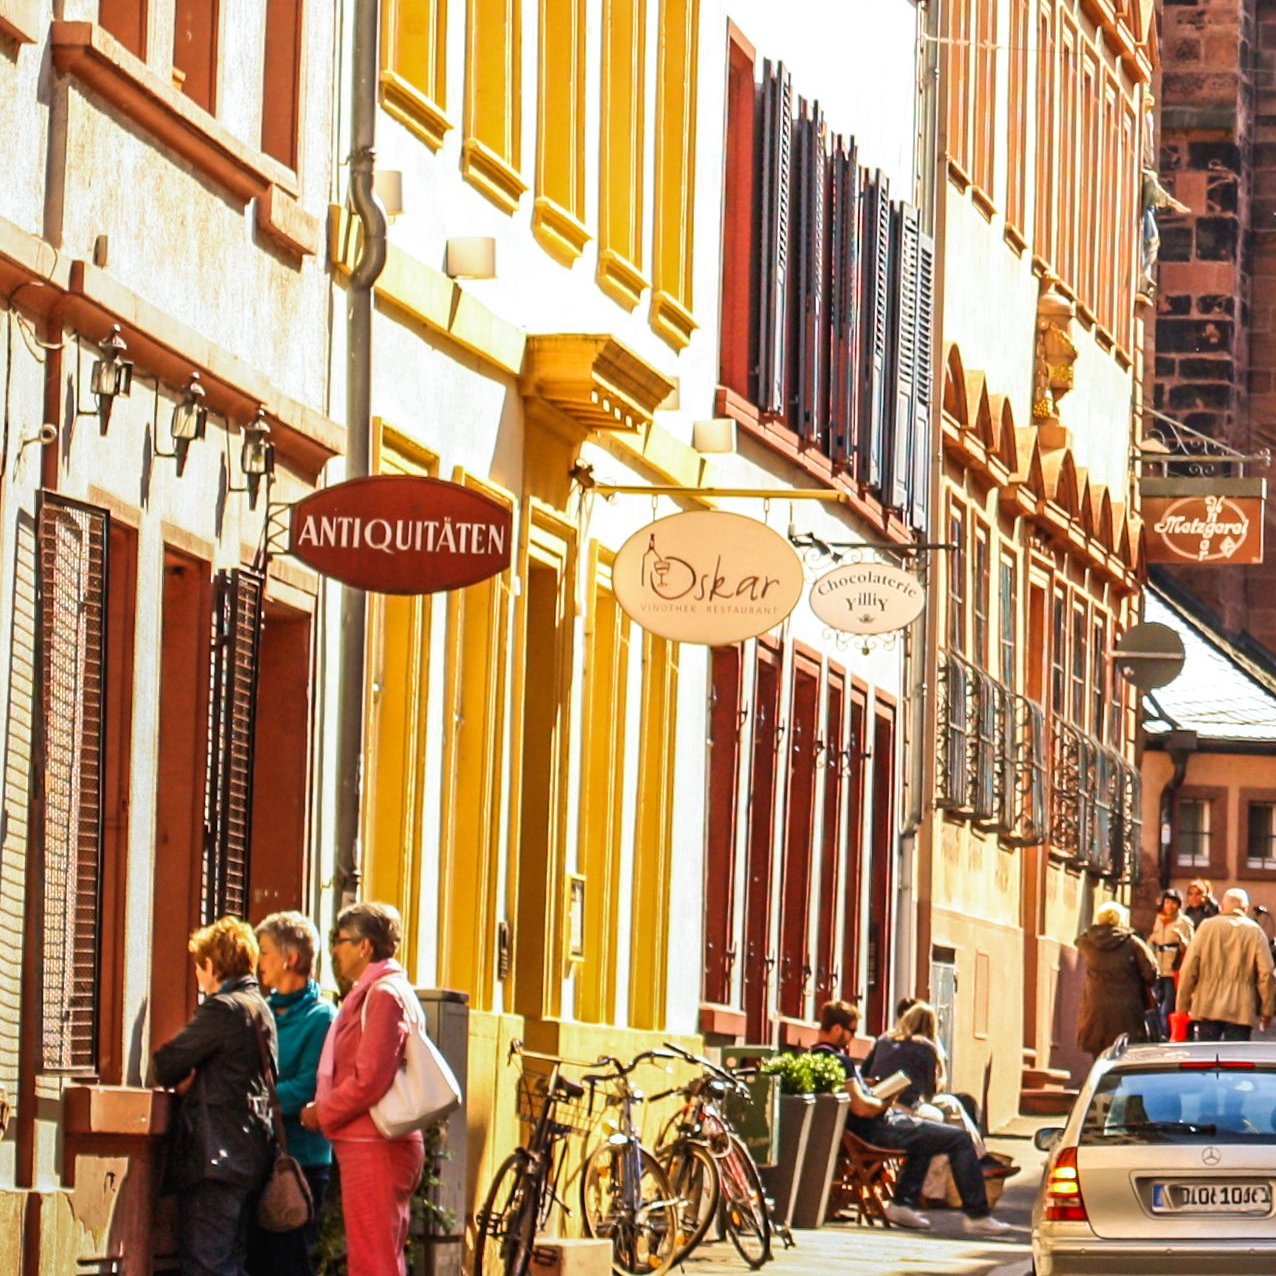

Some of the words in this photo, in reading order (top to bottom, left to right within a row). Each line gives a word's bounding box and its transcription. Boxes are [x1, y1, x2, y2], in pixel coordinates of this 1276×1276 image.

[297, 514, 505, 555] ANTIQUITÄTEN
[1154, 515, 1250, 539] Metzgerei
[649, 555, 780, 602] Oskar
[817, 570, 918, 599] Chocolaterie
[705, 604, 779, 616] RESTAURANT
